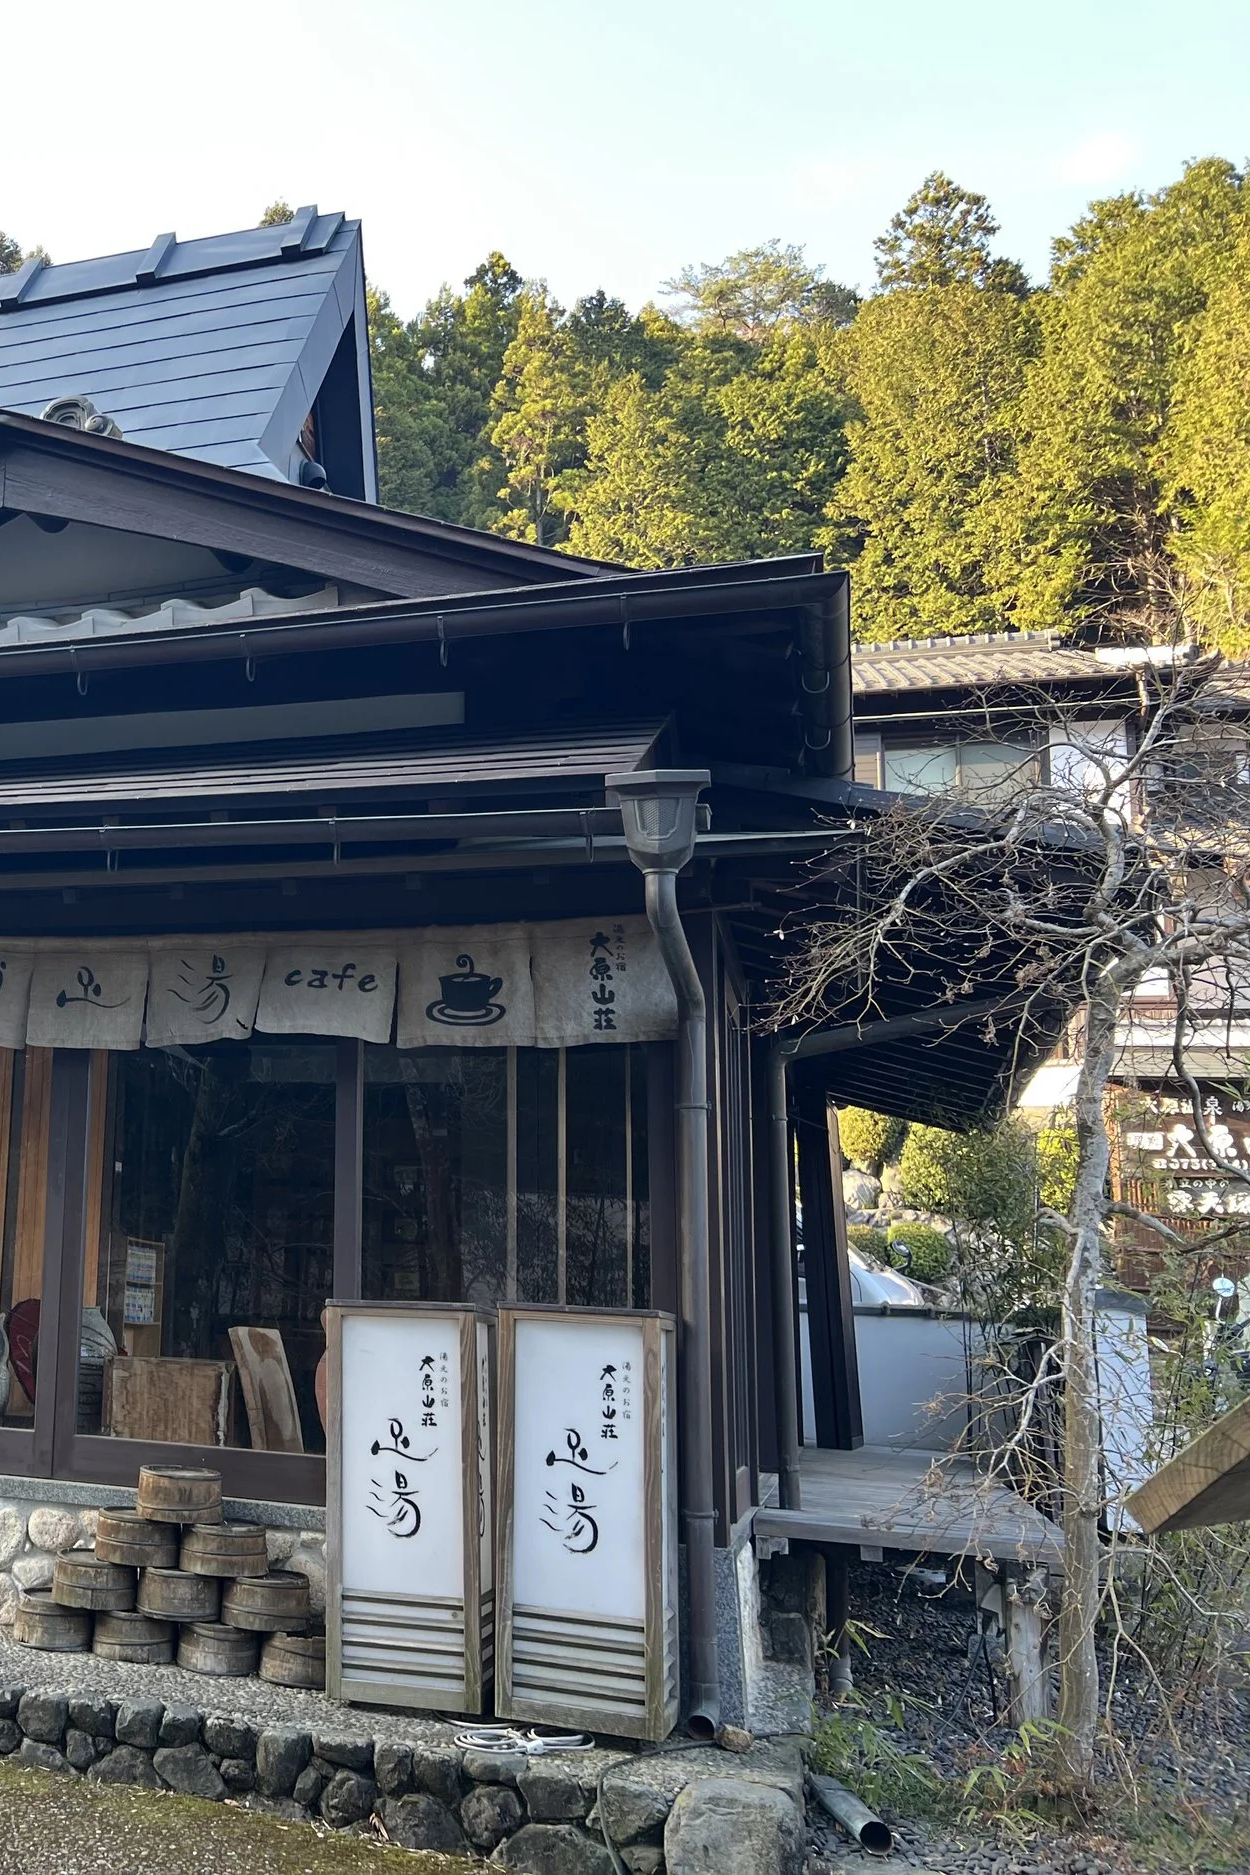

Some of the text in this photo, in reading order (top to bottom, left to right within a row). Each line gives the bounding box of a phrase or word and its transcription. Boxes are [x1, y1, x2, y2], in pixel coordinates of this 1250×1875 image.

[284, 962, 379, 994] cafe
[589, 931, 617, 1031] 大原山荘
[418, 1354, 438, 1428] 大原山荘
[439, 1351, 450, 1409] 湯元のお宿
[599, 1364, 619, 1440] 大原山荘
[621, 1360, 633, 1420] 湯元のお宿
[365, 1417, 439, 1539] 足湯
[538, 1427, 619, 1554] 足湯
